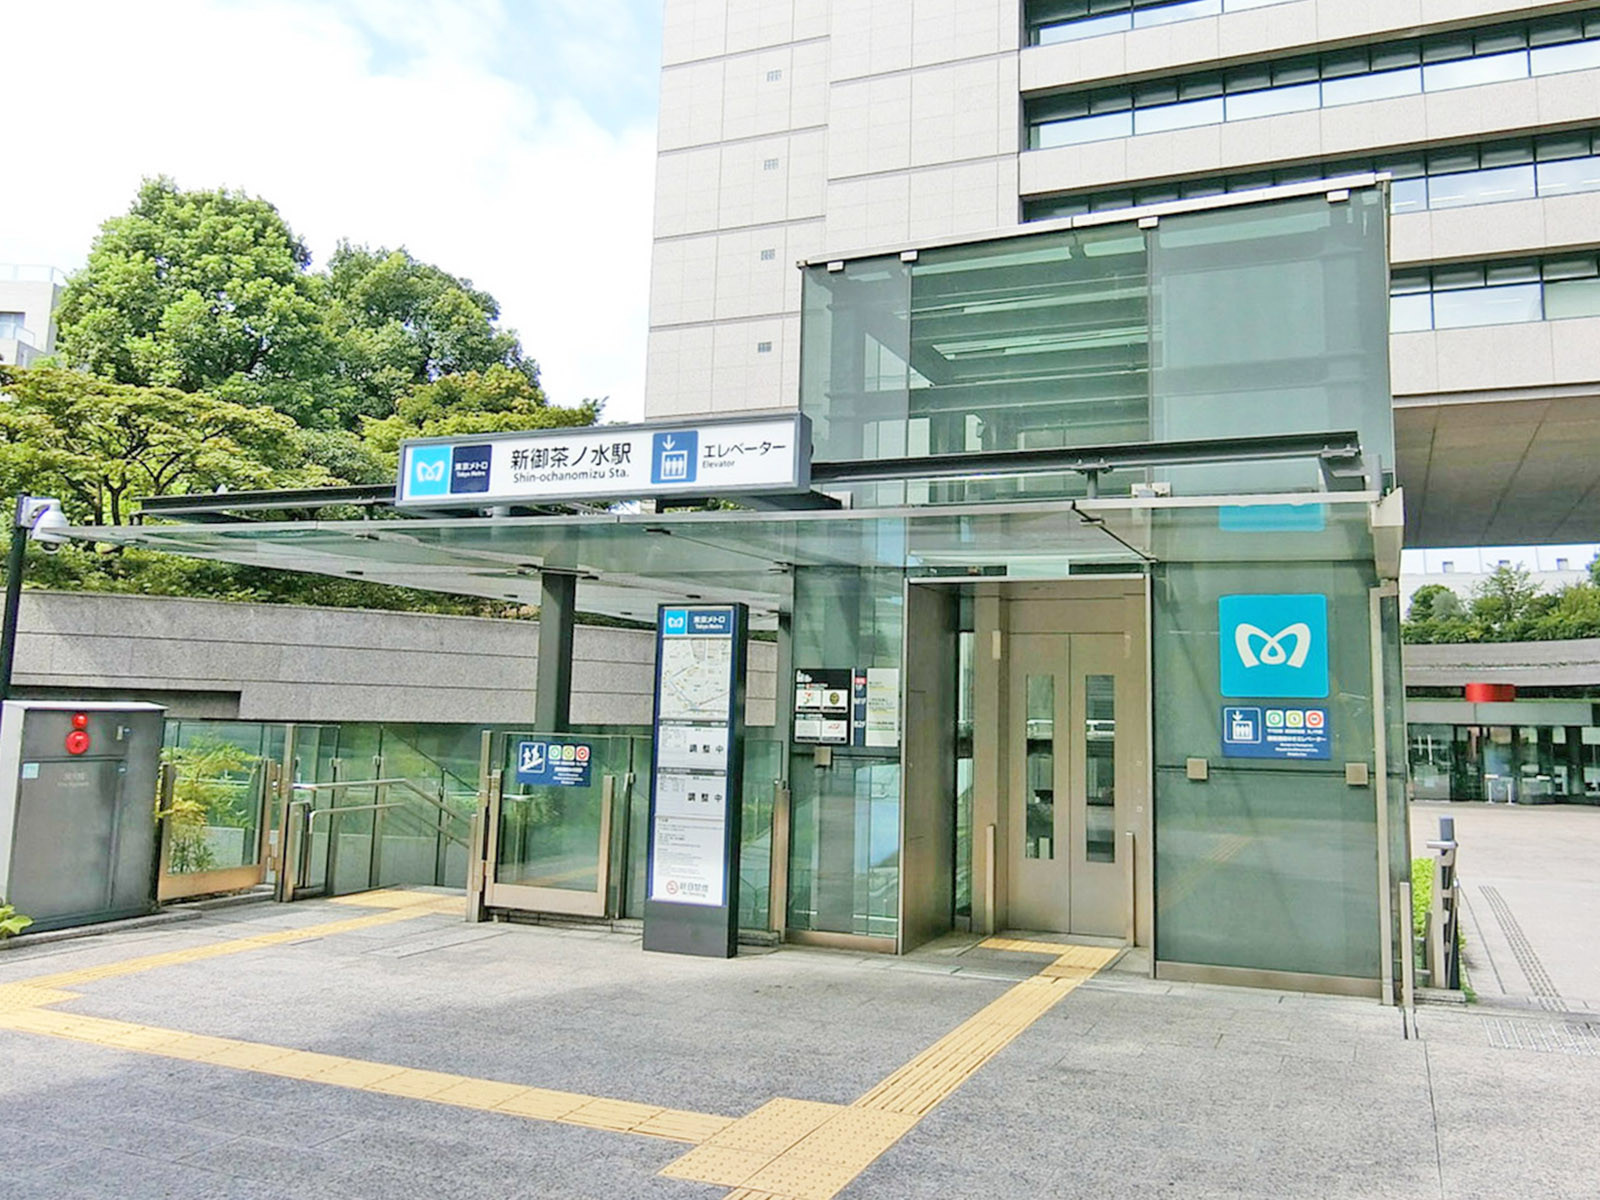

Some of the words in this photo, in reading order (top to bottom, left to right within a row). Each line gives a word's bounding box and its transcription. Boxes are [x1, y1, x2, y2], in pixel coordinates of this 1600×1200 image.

[510, 442, 631, 470] 新御茶ノ水駅
[703, 441, 786, 458] エレベーター
[702, 460, 735, 469] Elevator
[513, 468, 606, 484] Shin-ochanomizu
[609, 467, 630, 479] Sta.
